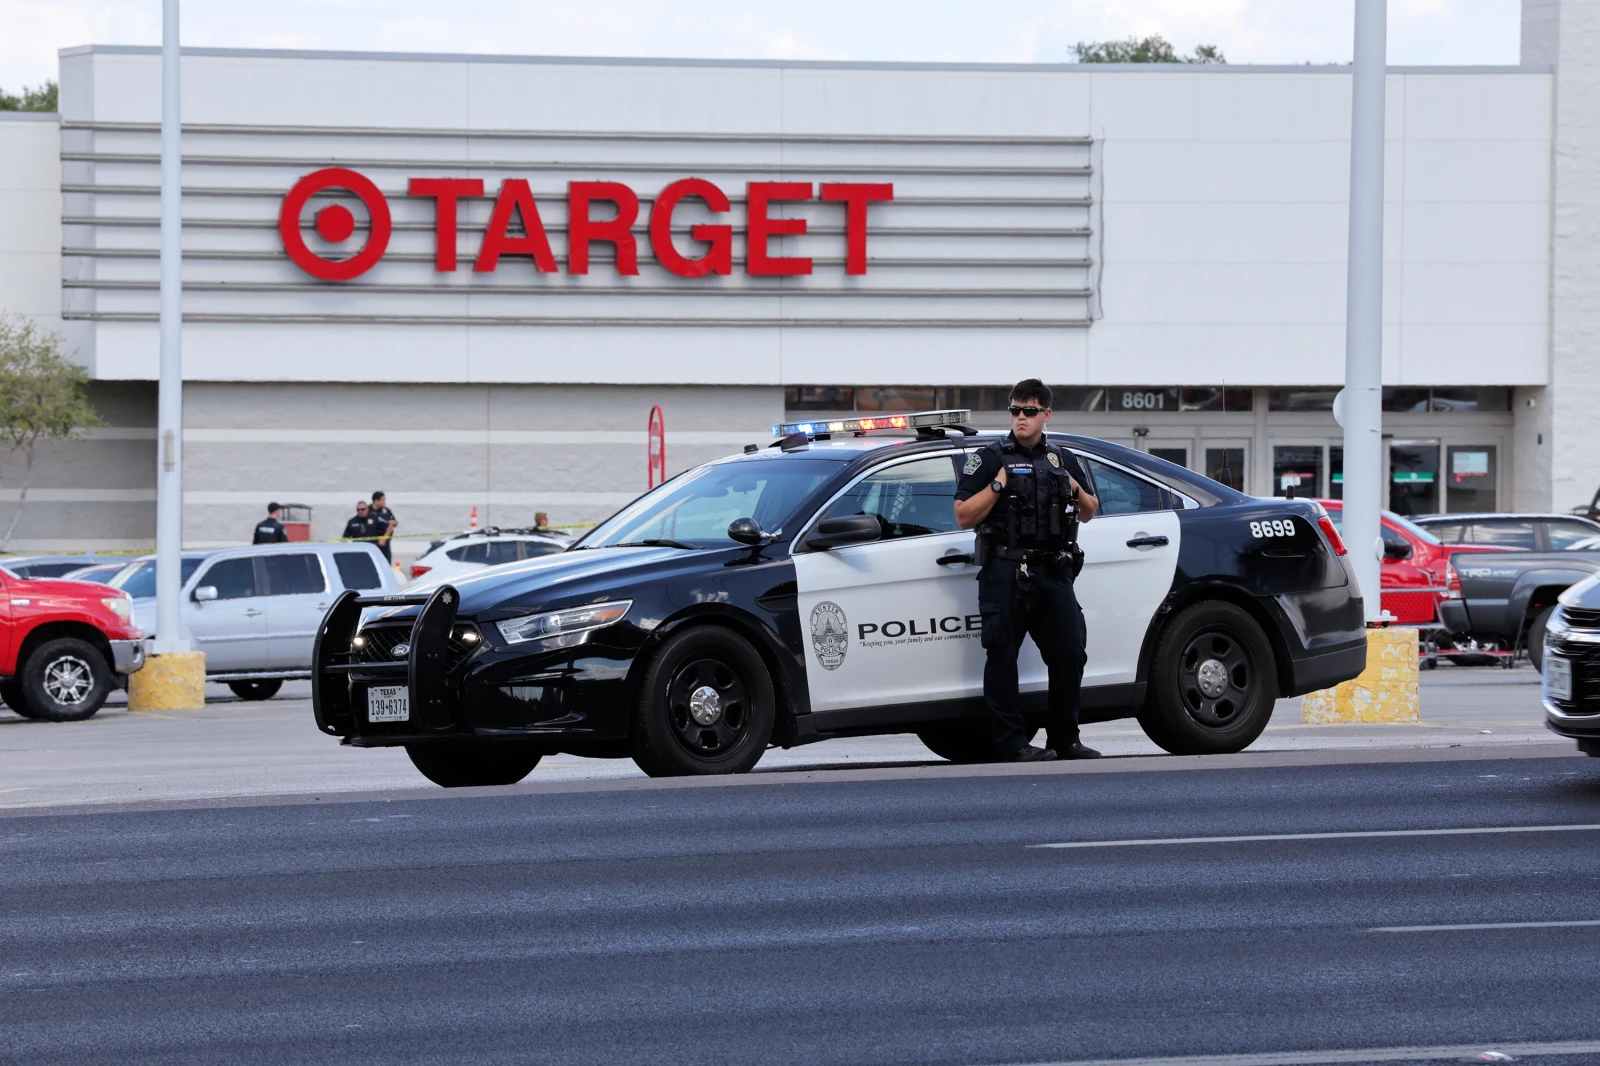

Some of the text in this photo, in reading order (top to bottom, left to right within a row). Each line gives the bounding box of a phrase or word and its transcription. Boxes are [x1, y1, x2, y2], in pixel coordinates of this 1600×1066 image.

[408, 177, 894, 277] TARGET
[1122, 392, 1164, 409] 8601
[1249, 519, 1296, 538] 8699
[1459, 568, 1491, 578] TRD
[815, 605, 839, 616] AUSTIN
[857, 614, 983, 640] POLICE
[907, 636, 923, 644] family
[943, 631, 971, 640] community
[380, 688, 397, 696] TEXAS
